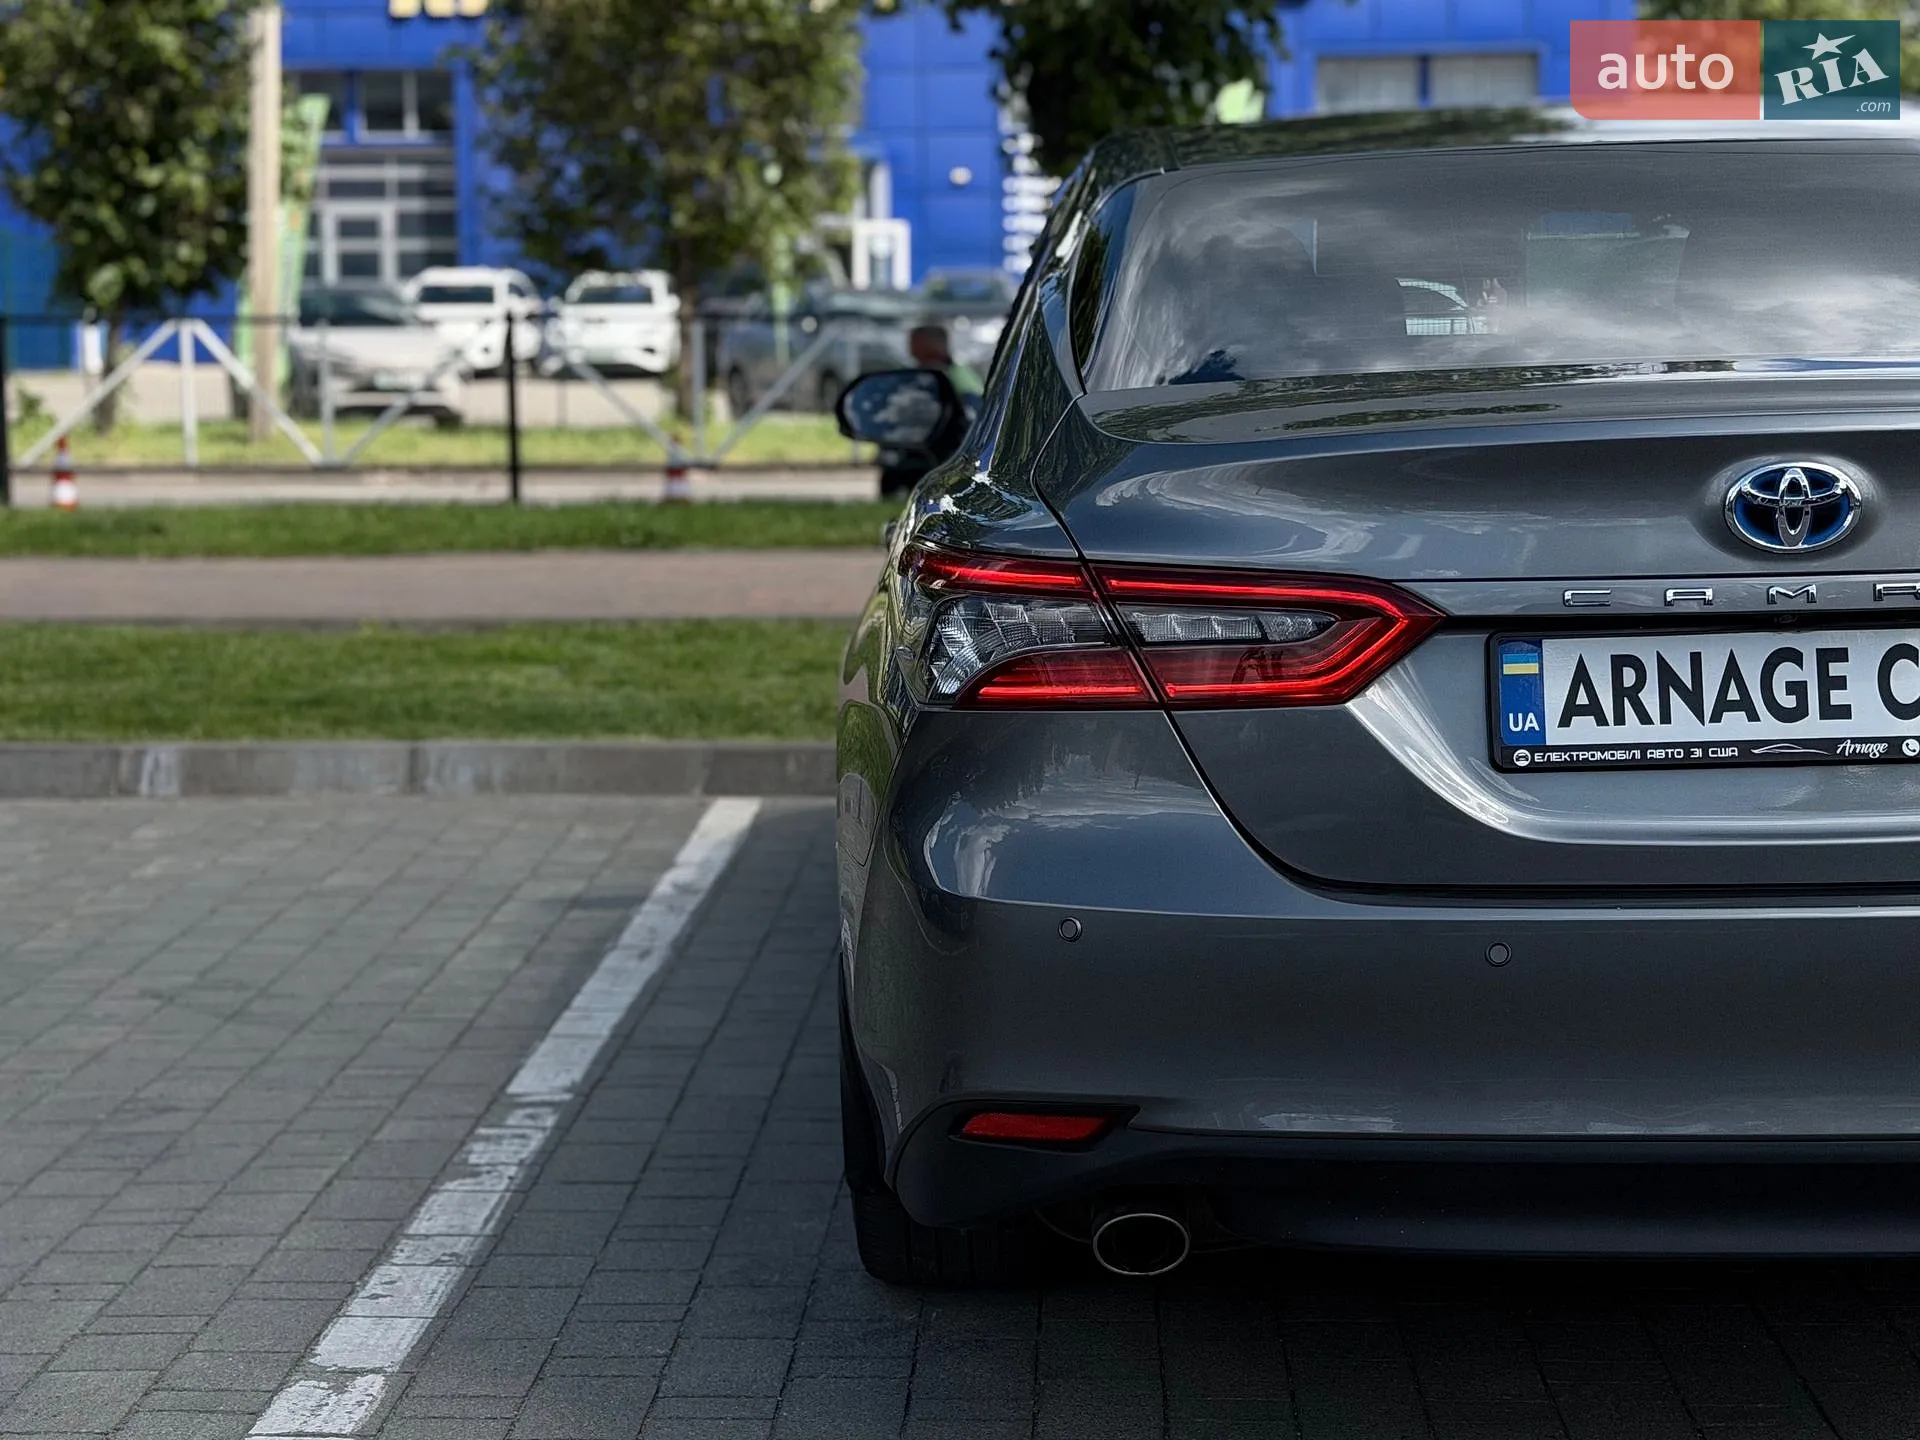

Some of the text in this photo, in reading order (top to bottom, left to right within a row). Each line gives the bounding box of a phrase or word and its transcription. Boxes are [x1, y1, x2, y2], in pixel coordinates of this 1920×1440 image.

[1557, 643, 1920, 729] ARNAGE C
[1508, 712, 1540, 732] UA
[1534, 747, 1739, 763] ЕЛЕКТРОМОБІЛІ АВТО ЗІ США
[1836, 739, 1889, 758] Arnage
